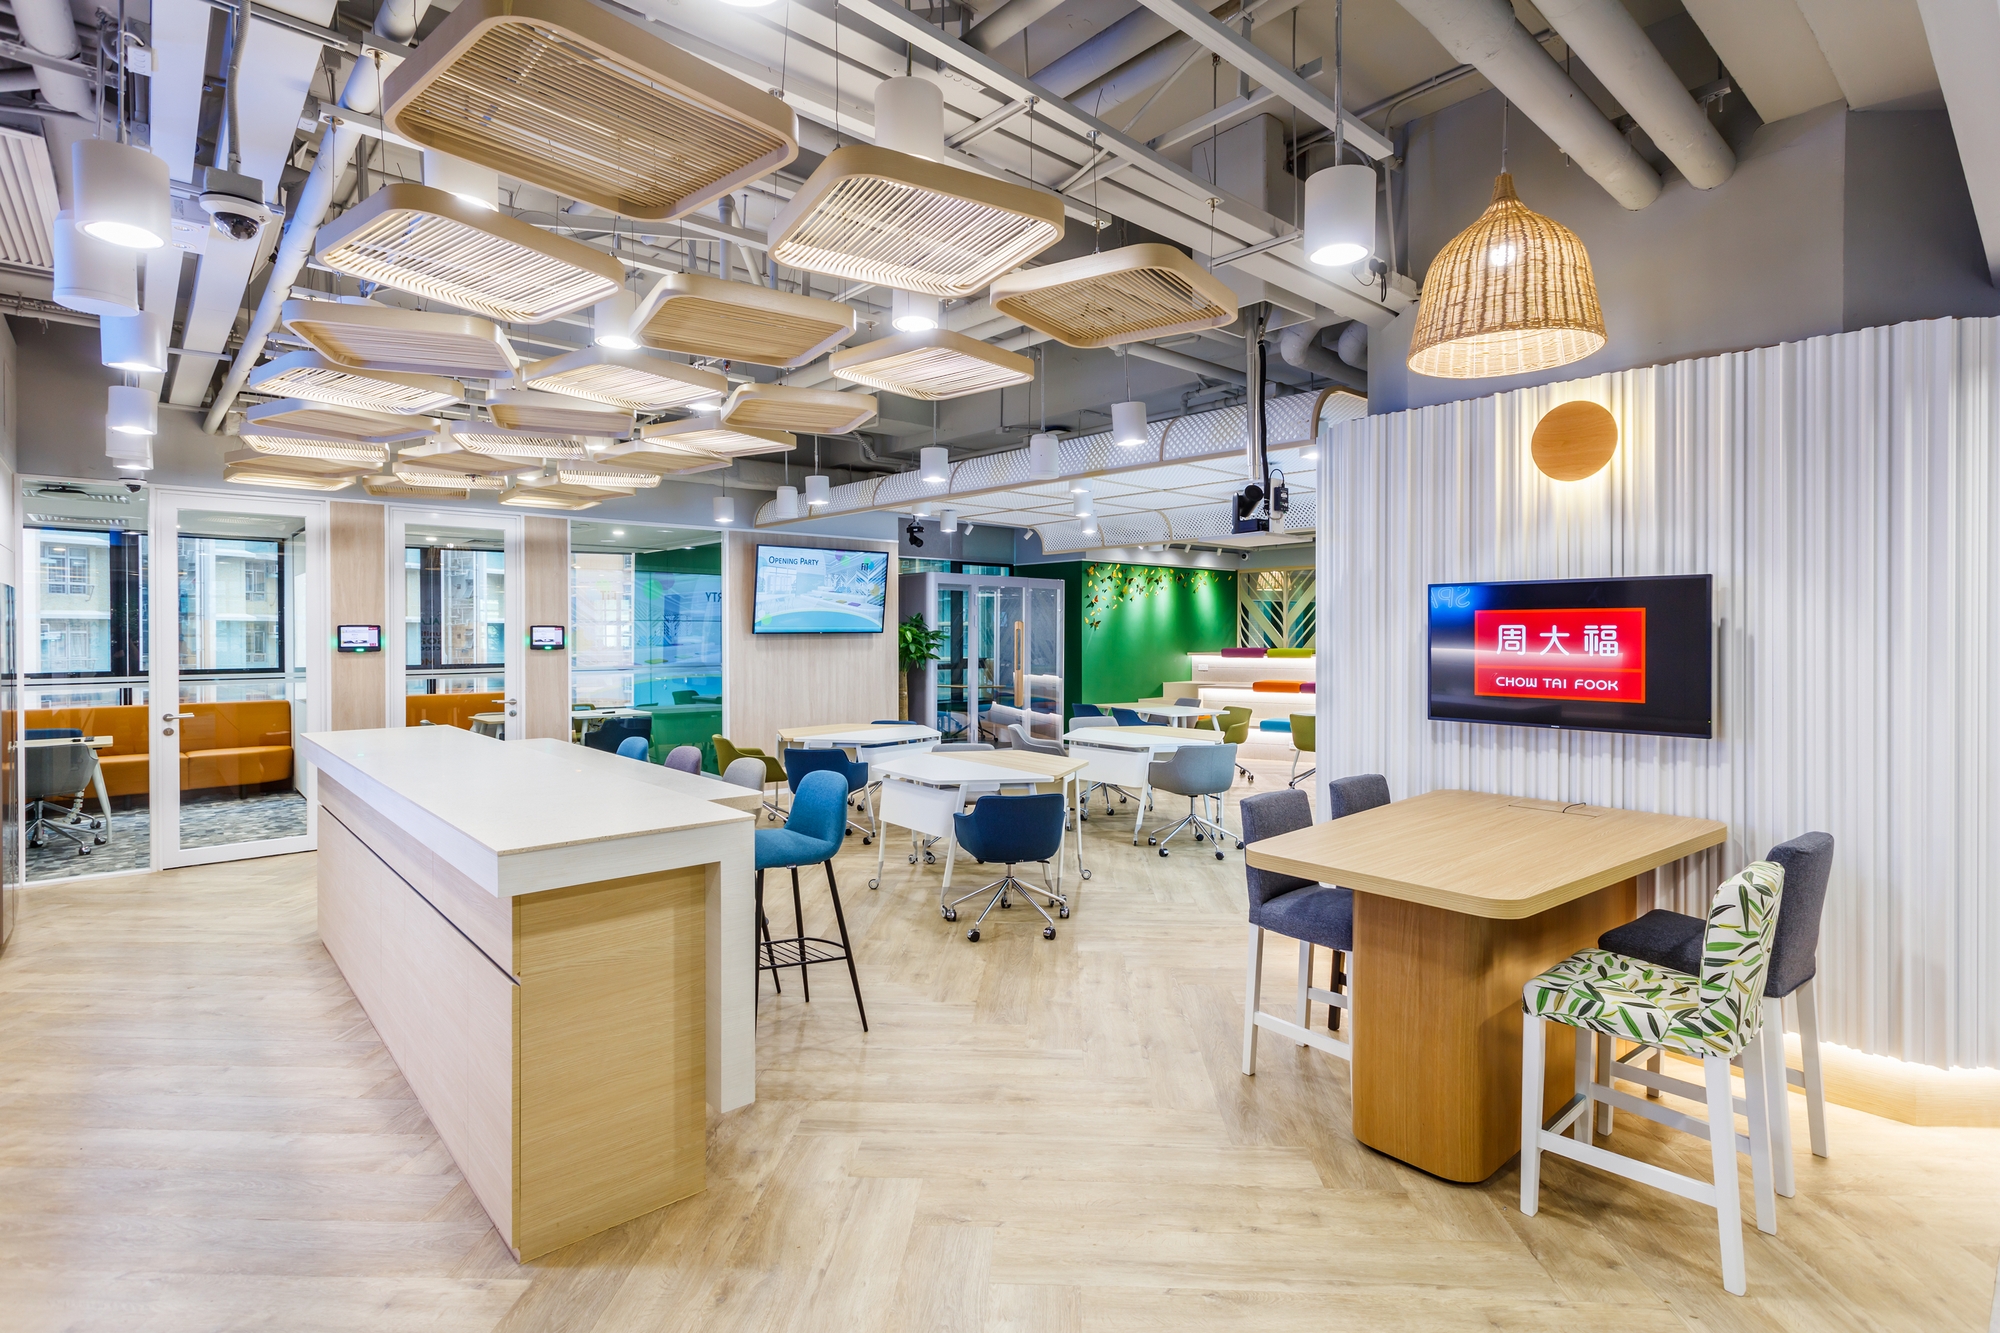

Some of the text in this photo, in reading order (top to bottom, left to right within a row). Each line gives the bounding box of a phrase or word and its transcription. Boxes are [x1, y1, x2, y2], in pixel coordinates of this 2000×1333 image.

[1496, 624, 1619, 657] 周大福
[1495, 676, 1619, 691] CHOW TAI FOOK
